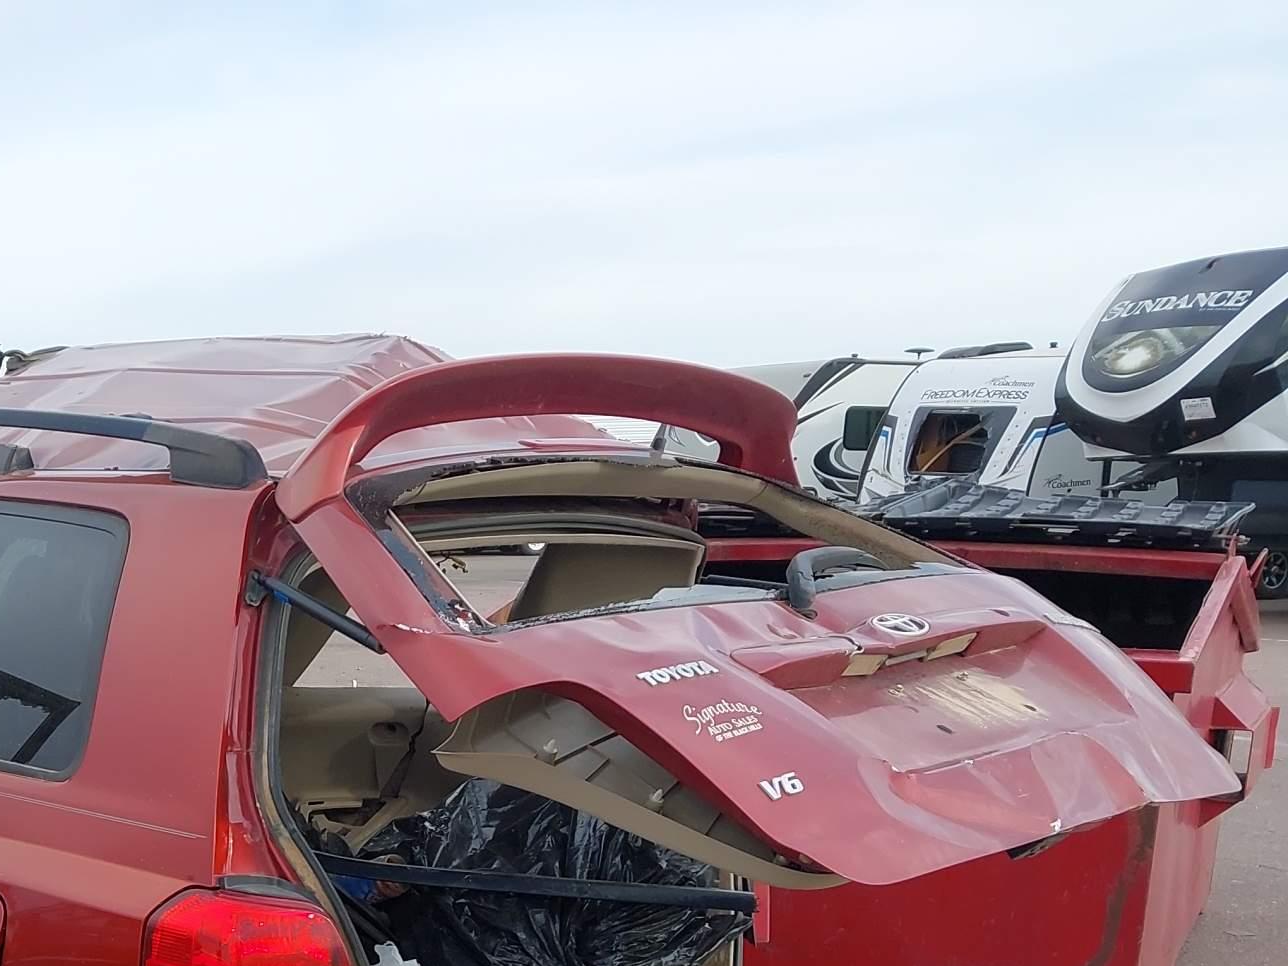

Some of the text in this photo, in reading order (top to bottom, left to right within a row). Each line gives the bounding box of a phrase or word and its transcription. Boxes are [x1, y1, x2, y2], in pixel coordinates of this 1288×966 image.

[1101, 289, 1254, 322] SUNDANCE
[921, 387, 1030, 400] FREEDOM EXPRESS
[993, 379, 1036, 388] Coachmen
[1051, 479, 1091, 489] Coachmen
[637, 660, 720, 687] TOYOTA
[683, 699, 762, 735] Signature
[707, 715, 759, 736] AUTO SALES
[758, 771, 804, 801] V6
